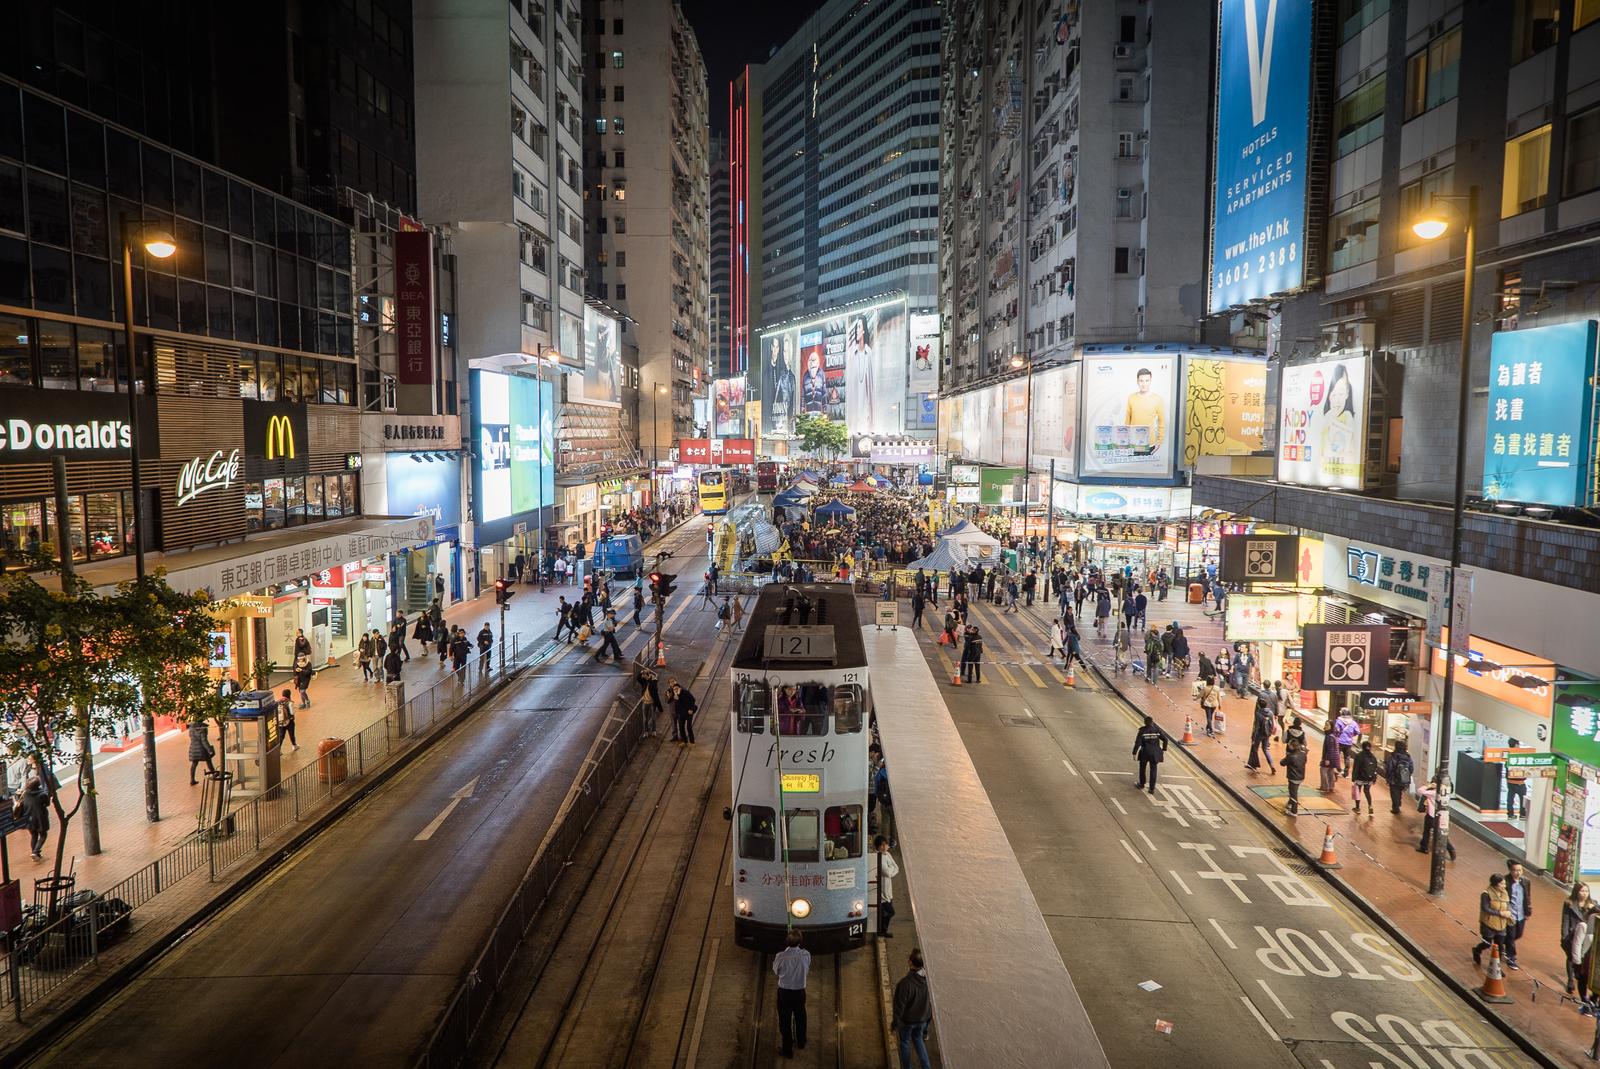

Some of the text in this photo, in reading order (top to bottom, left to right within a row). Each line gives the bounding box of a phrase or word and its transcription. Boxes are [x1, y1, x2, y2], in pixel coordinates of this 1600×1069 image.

[1242, 127, 1278, 159] HOTELS
[1256, 156, 1262, 165] &
[1227, 151, 1294, 199] SERVICED
[1227, 170, 1292, 215] APARTMENTS
[1225, 217, 1290, 260] www.theV.hk
[1217, 242, 1296, 289] 3602 2388
[401, 291, 424, 300] BEA
[406, 306, 423, 372] 東亞銀行
[1497, 361, 1543, 386] 為讀者
[1495, 398, 1524, 421] 找書
[1493, 433, 1571, 457] 為書找讀者
[177, 448, 240, 501] McCafé
[221, 542, 343, 592] 東亞銀行顯卓理財中心
[367, 535, 389, 551] Times
[390, 530, 414, 549] Square
[780, 637, 811, 655] 121
[736, 673, 750, 682] 121
[843, 673, 858, 682] 121
[766, 742, 835, 767] fresh
[849, 924, 863, 936] 121
[1253, 925, 1425, 982] STOP
[1330, 1011, 1500, 1069] BUS
